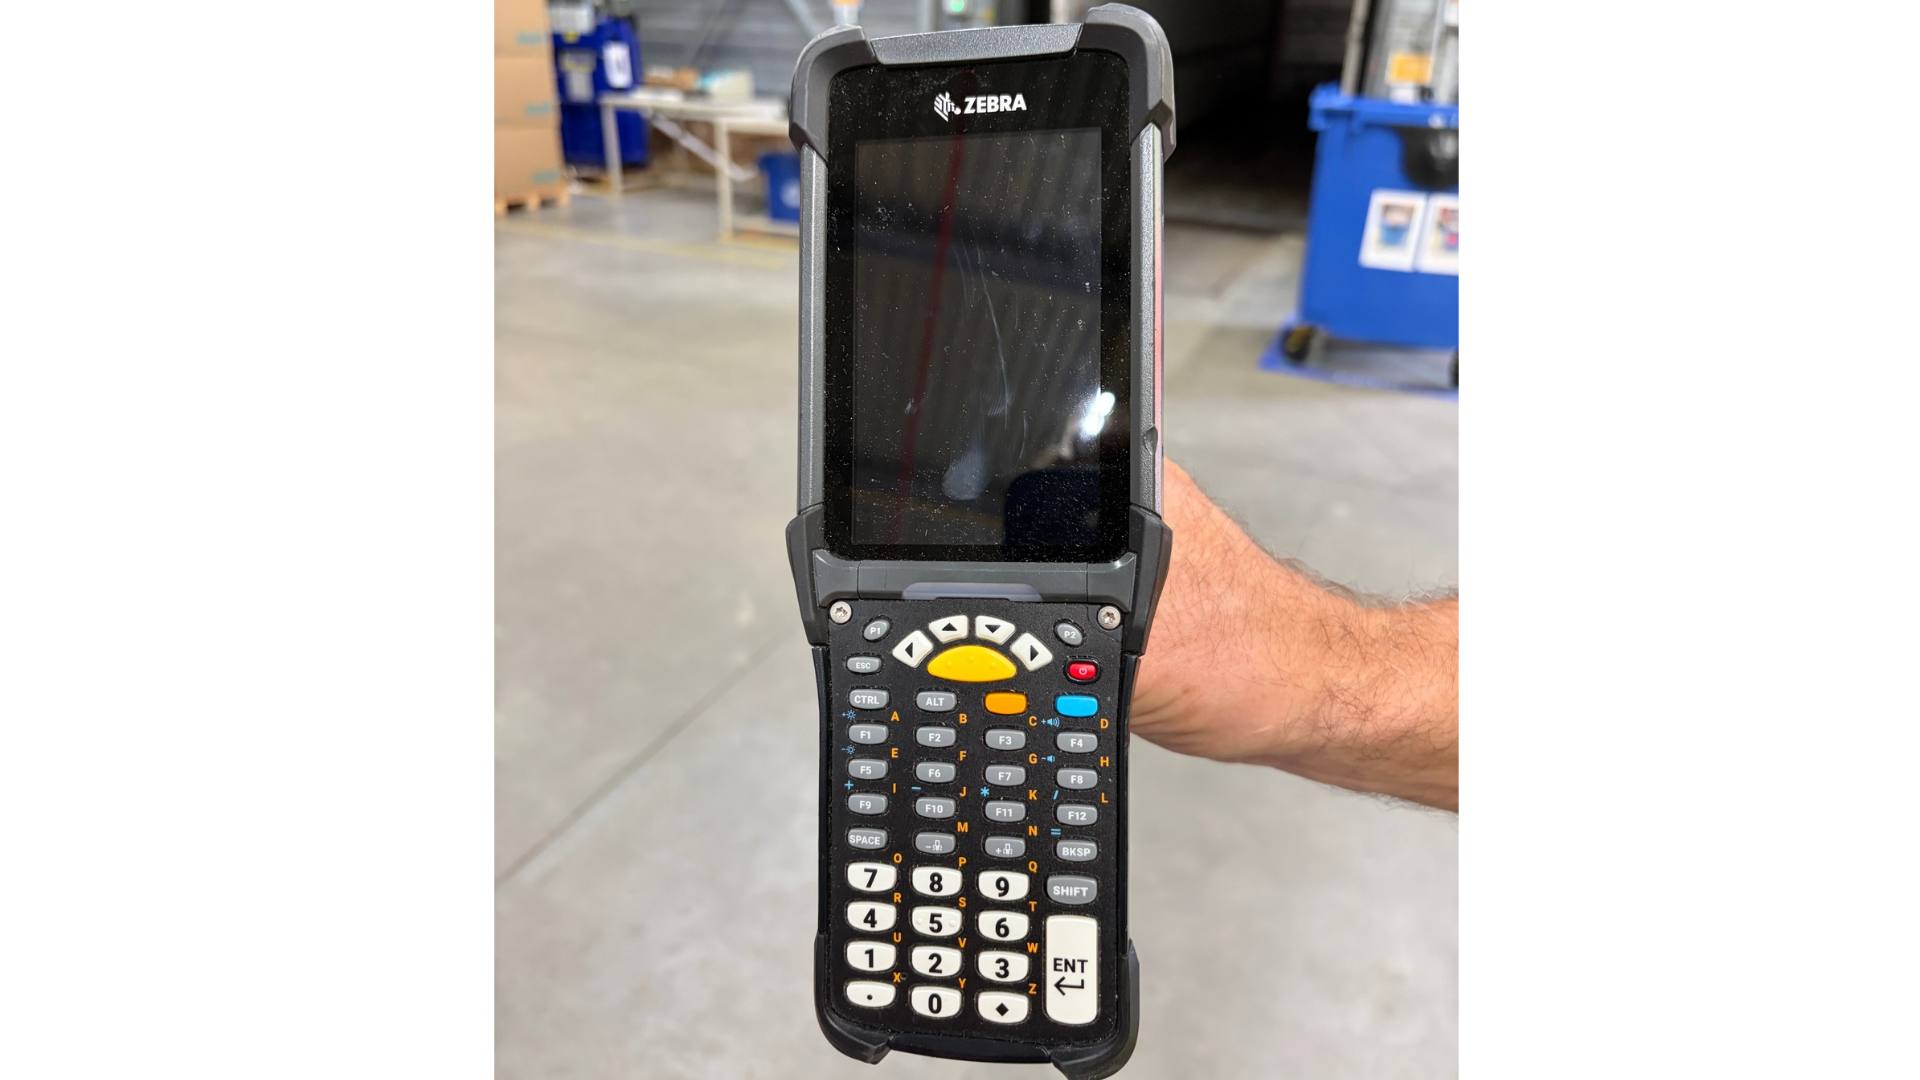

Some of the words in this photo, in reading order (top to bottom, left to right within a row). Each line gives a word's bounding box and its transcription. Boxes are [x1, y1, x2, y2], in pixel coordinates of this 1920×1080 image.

[964, 93, 1027, 114] ZEBRA
[870, 627, 881, 635] P1
[1064, 630, 1076, 639] P2
[856, 661, 871, 669] ESC
[854, 695, 880, 705] CTRL
[925, 697, 945, 706] ALT
[890, 711, 900, 722] A
[959, 713, 967, 724] B
[1029, 716, 1037, 726] C
[1100, 719, 1109, 729] D
[860, 730, 871, 739] F1
[929, 733, 941, 742] F2
[999, 736, 1012, 745] F3
[1071, 738, 1083, 747] F4
[892, 748, 898, 758] E
[959, 751, 966, 761] F
[1028, 753, 1037, 764] G
[1100, 755, 1109, 767] H
[860, 766, 872, 774] F5
[929, 769, 941, 777] F6
[998, 772, 1011, 781] F7
[1071, 775, 1083, 784] F8
[960, 787, 967, 798] J
[1028, 789, 1037, 801] K
[1100, 794, 1108, 804] L
[860, 801, 871, 809] F9
[925, 804, 943, 813] F10
[996, 807, 1013, 816] F11
[1068, 811, 1086, 820] F12
[957, 822, 968, 833] M
[1028, 825, 1037, 837] N
[850, 835, 880, 845] SPACE
[1062, 847, 1090, 856] BKSP
[958, 856, 967, 866] P
[1028, 861, 1037, 872] Q
[864, 869, 877, 888] 7
[930, 873, 942, 892] 8
[996, 877, 1009, 897] 9
[1053, 886, 1088, 896] SHIFT
[893, 892, 902, 904] R
[958, 896, 967, 908] S
[1028, 900, 1037, 912] T
[864, 909, 877, 928] 4
[929, 913, 942, 933] 5
[996, 918, 1009, 937] 6
[893, 931, 902, 943] U
[957, 937, 967, 949] V
[1026, 942, 1039, 954] W
[865, 949, 873, 968] 1
[929, 953, 942, 973] 2
[995, 958, 1009, 978] 3
[1053, 958, 1088, 972] ENT
[893, 972, 901, 982] X
[958, 977, 966, 989] Y
[1028, 983, 1037, 995] Z
[929, 994, 941, 1014] 0
